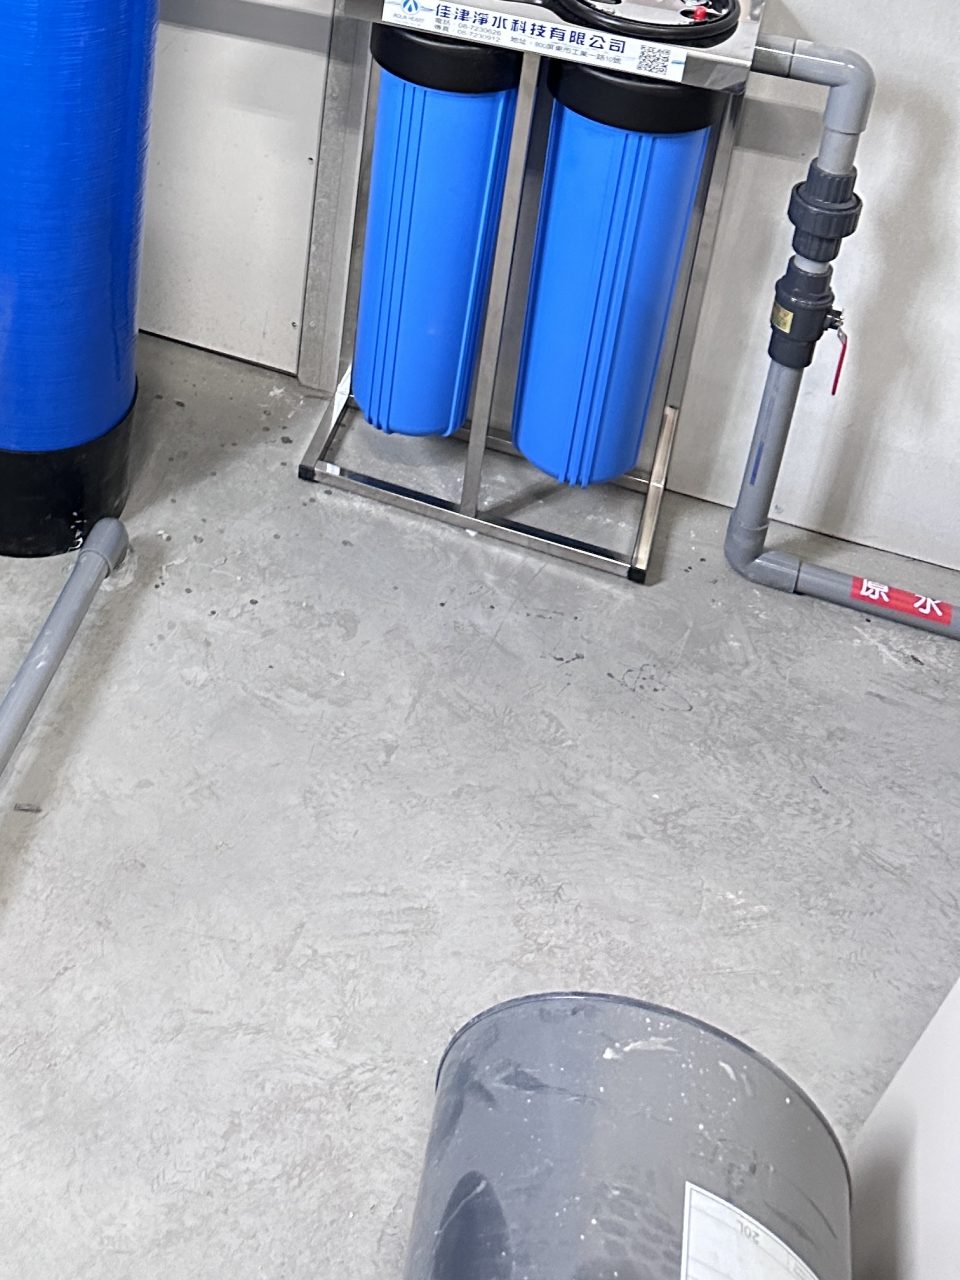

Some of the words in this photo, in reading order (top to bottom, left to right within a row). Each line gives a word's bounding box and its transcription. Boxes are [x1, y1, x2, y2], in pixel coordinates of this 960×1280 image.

[435, 3, 626, 54] 佳津淨水科技有限公司
